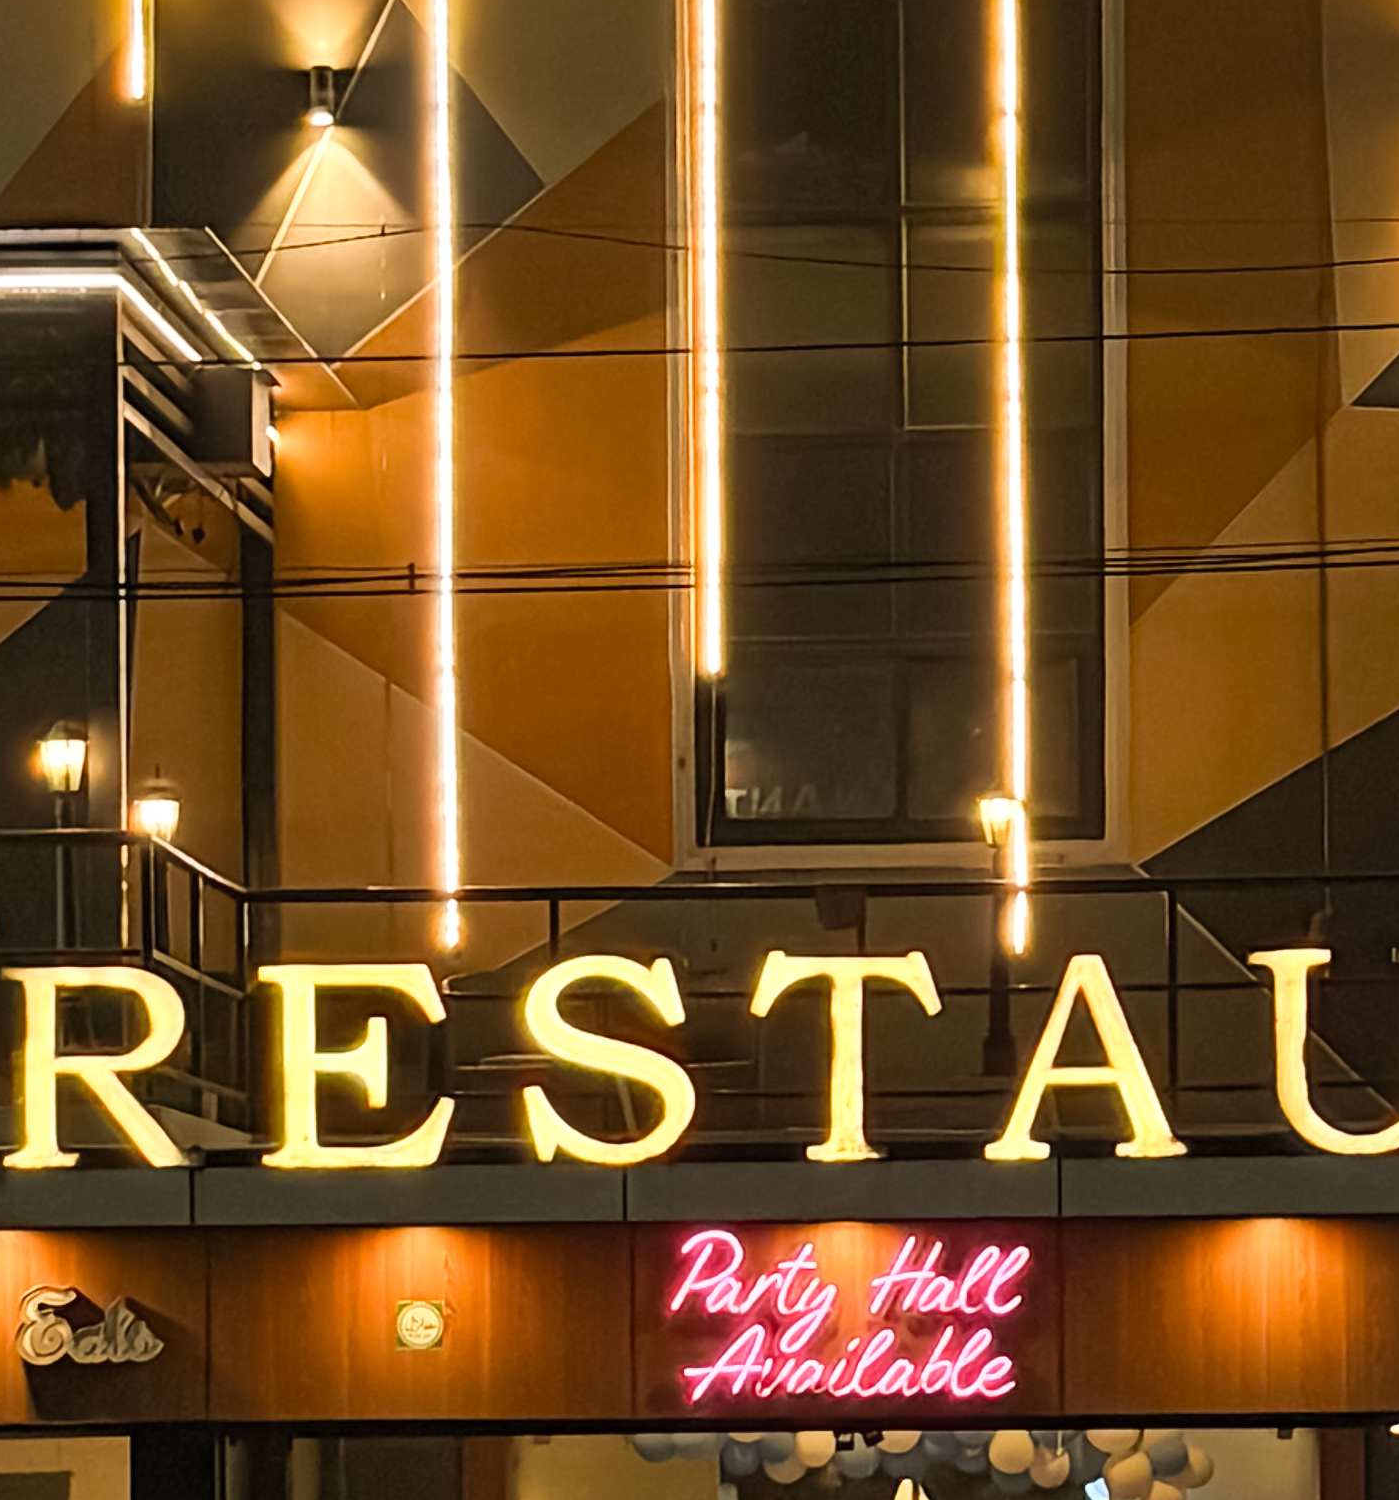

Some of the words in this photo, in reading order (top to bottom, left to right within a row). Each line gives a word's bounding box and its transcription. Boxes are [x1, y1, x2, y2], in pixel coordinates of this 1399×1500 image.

[670, 1229, 838, 1353] Party
[869, 1235, 1031, 1314] Hall
[683, 1324, 1017, 1401] Available
